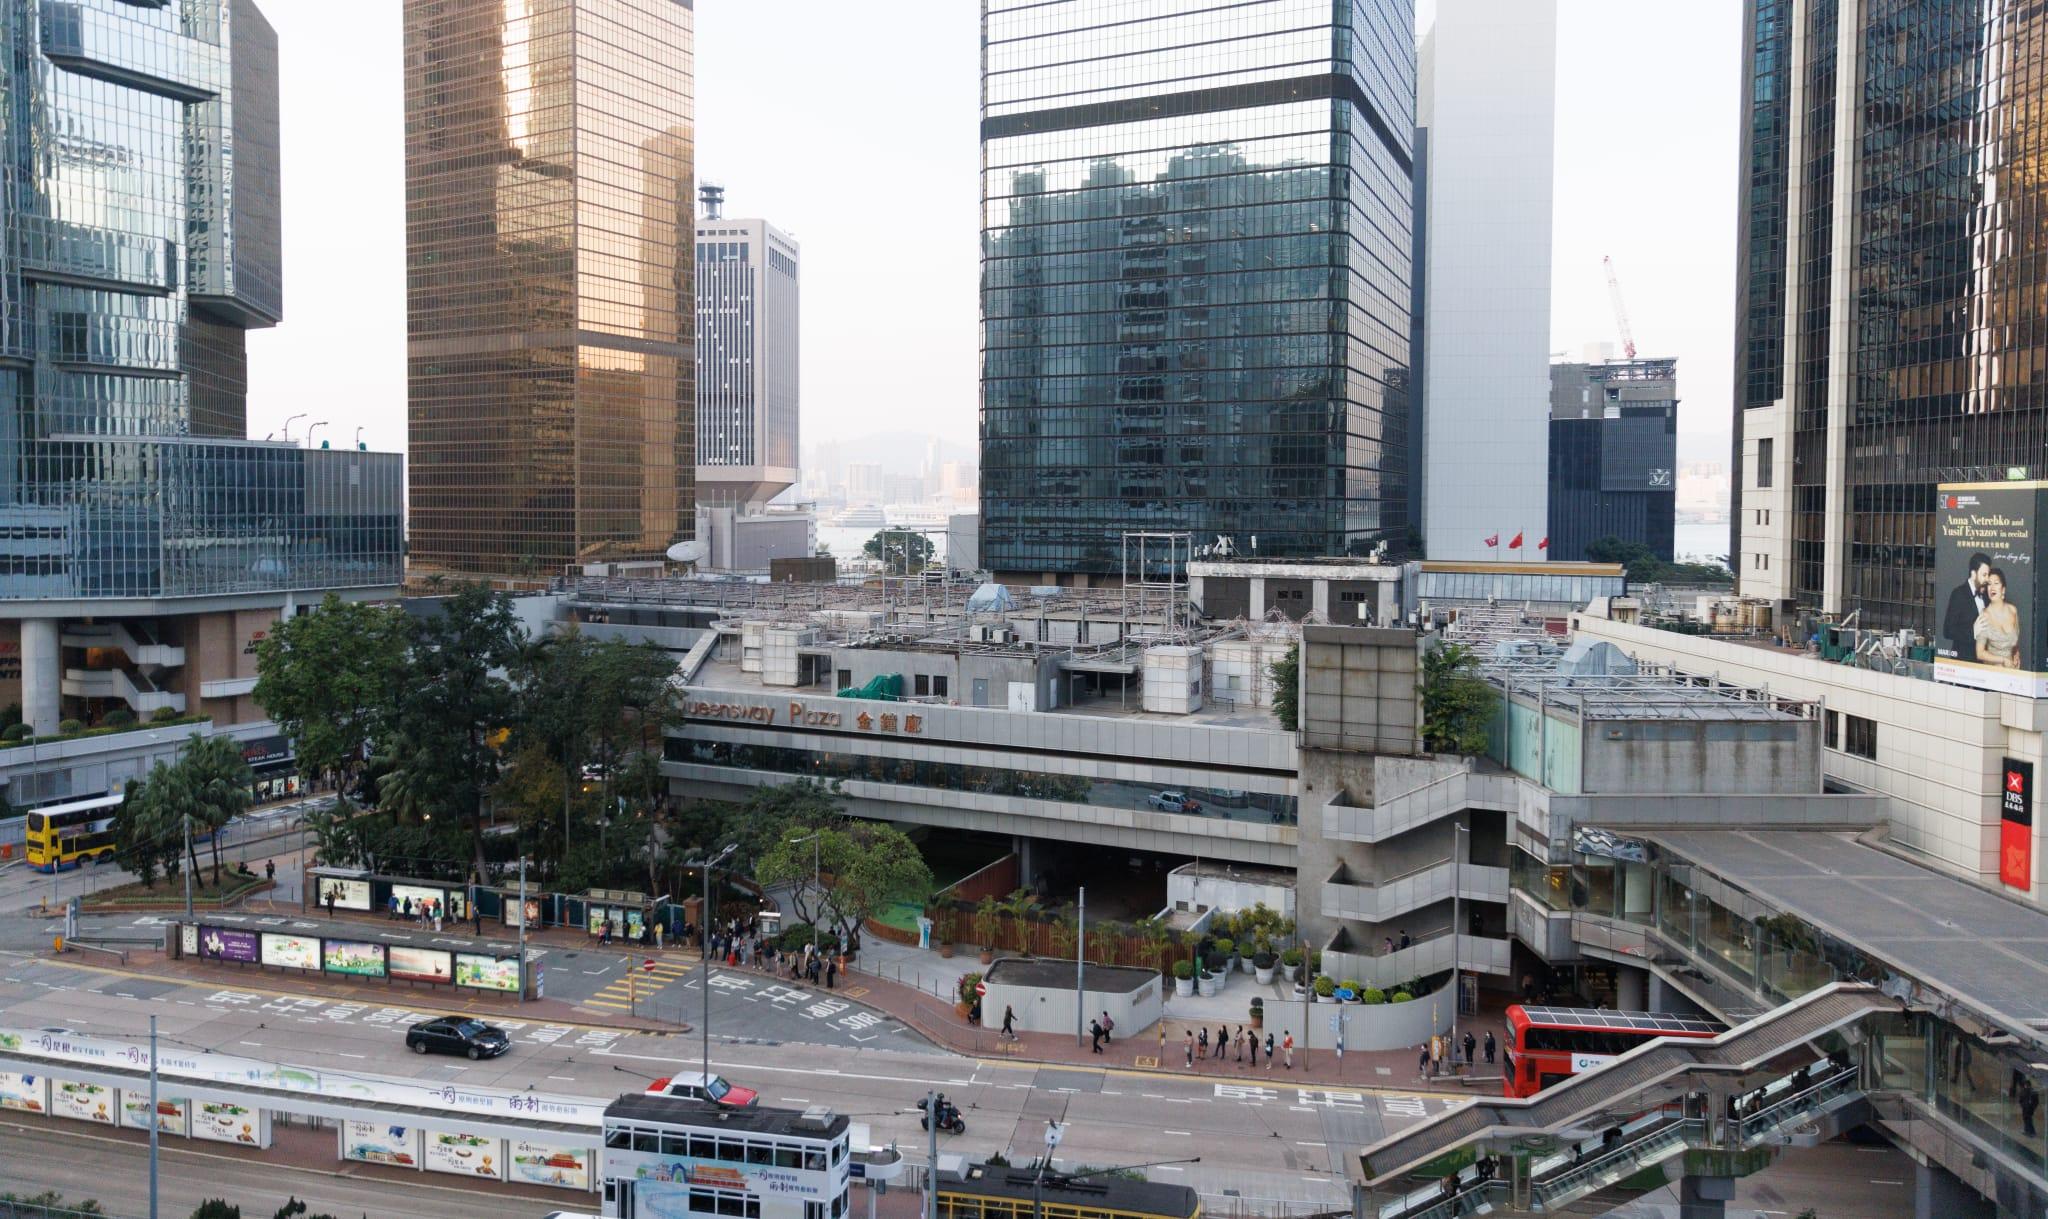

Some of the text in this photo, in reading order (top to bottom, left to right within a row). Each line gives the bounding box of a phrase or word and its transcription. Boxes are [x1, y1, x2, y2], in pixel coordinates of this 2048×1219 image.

[1947, 514, 2024, 526] Anna Netrebko and
[1942, 525, 1964, 537] Yusif
[1965, 526, 1998, 540] Eyvazov
[2008, 530, 2028, 538] recital
[682, 701, 775, 725] ueensway
[789, 702, 841, 727] Plaza
[248, 755, 266, 763] STEAK
[2006, 791, 2023, 804] DBS
[707, 974, 755, 990] 站
[755, 984, 813, 1005] 巴士
[261, 996, 327, 1012] 巴士
[805, 998, 850, 1018] STOP
[362, 1007, 412, 1023] BUS
[838, 1011, 883, 1030] BUS
[575, 1030, 623, 1046] BUS
[1298, 1089, 1364, 1107] 巴士
